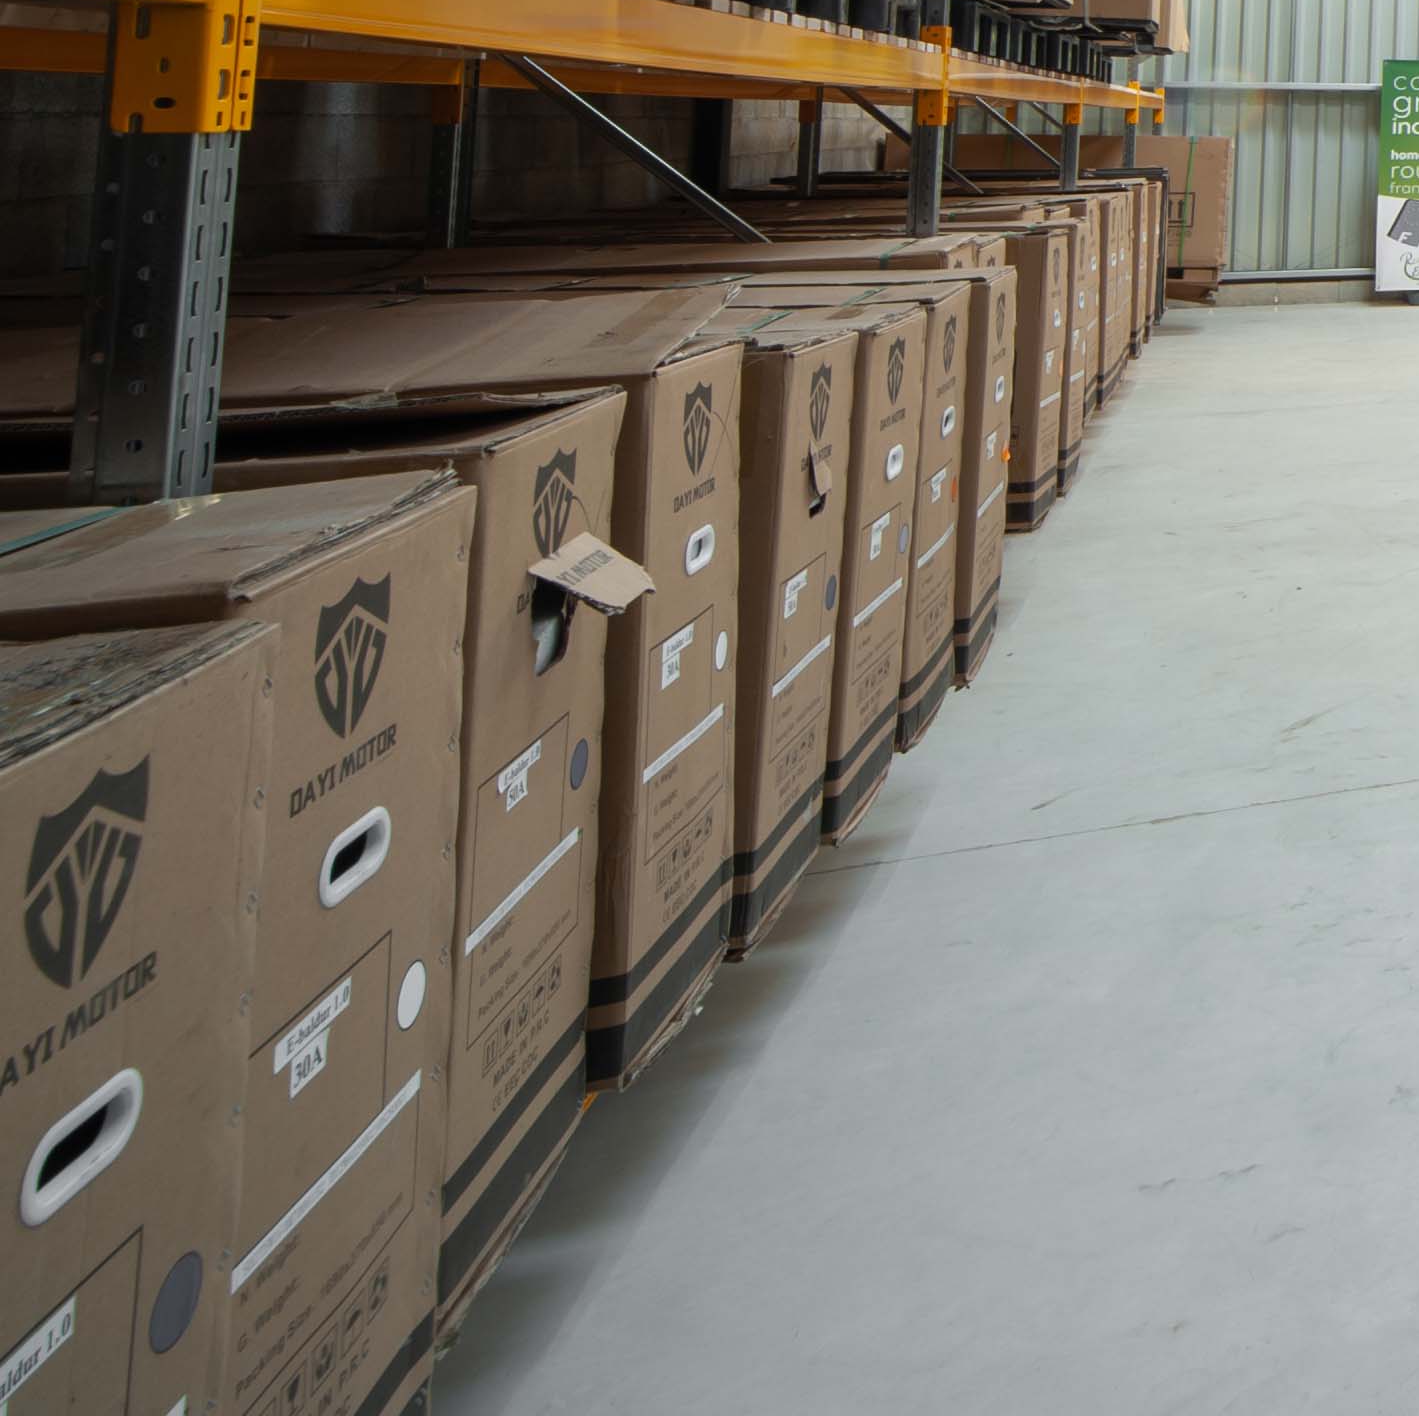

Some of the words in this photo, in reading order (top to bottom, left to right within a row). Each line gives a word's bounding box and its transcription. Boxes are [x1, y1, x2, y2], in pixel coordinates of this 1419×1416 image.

[674, 489, 692, 513] DAYI
[693, 477, 715, 503] MOTOR
[570, 550, 614, 579] MOTOR
[289, 764, 337, 818] DAYI
[339, 723, 397, 784] MOTOR
[59, 951, 158, 1051] MOTOR
[46, 1312, 73, 1353] 1.0
